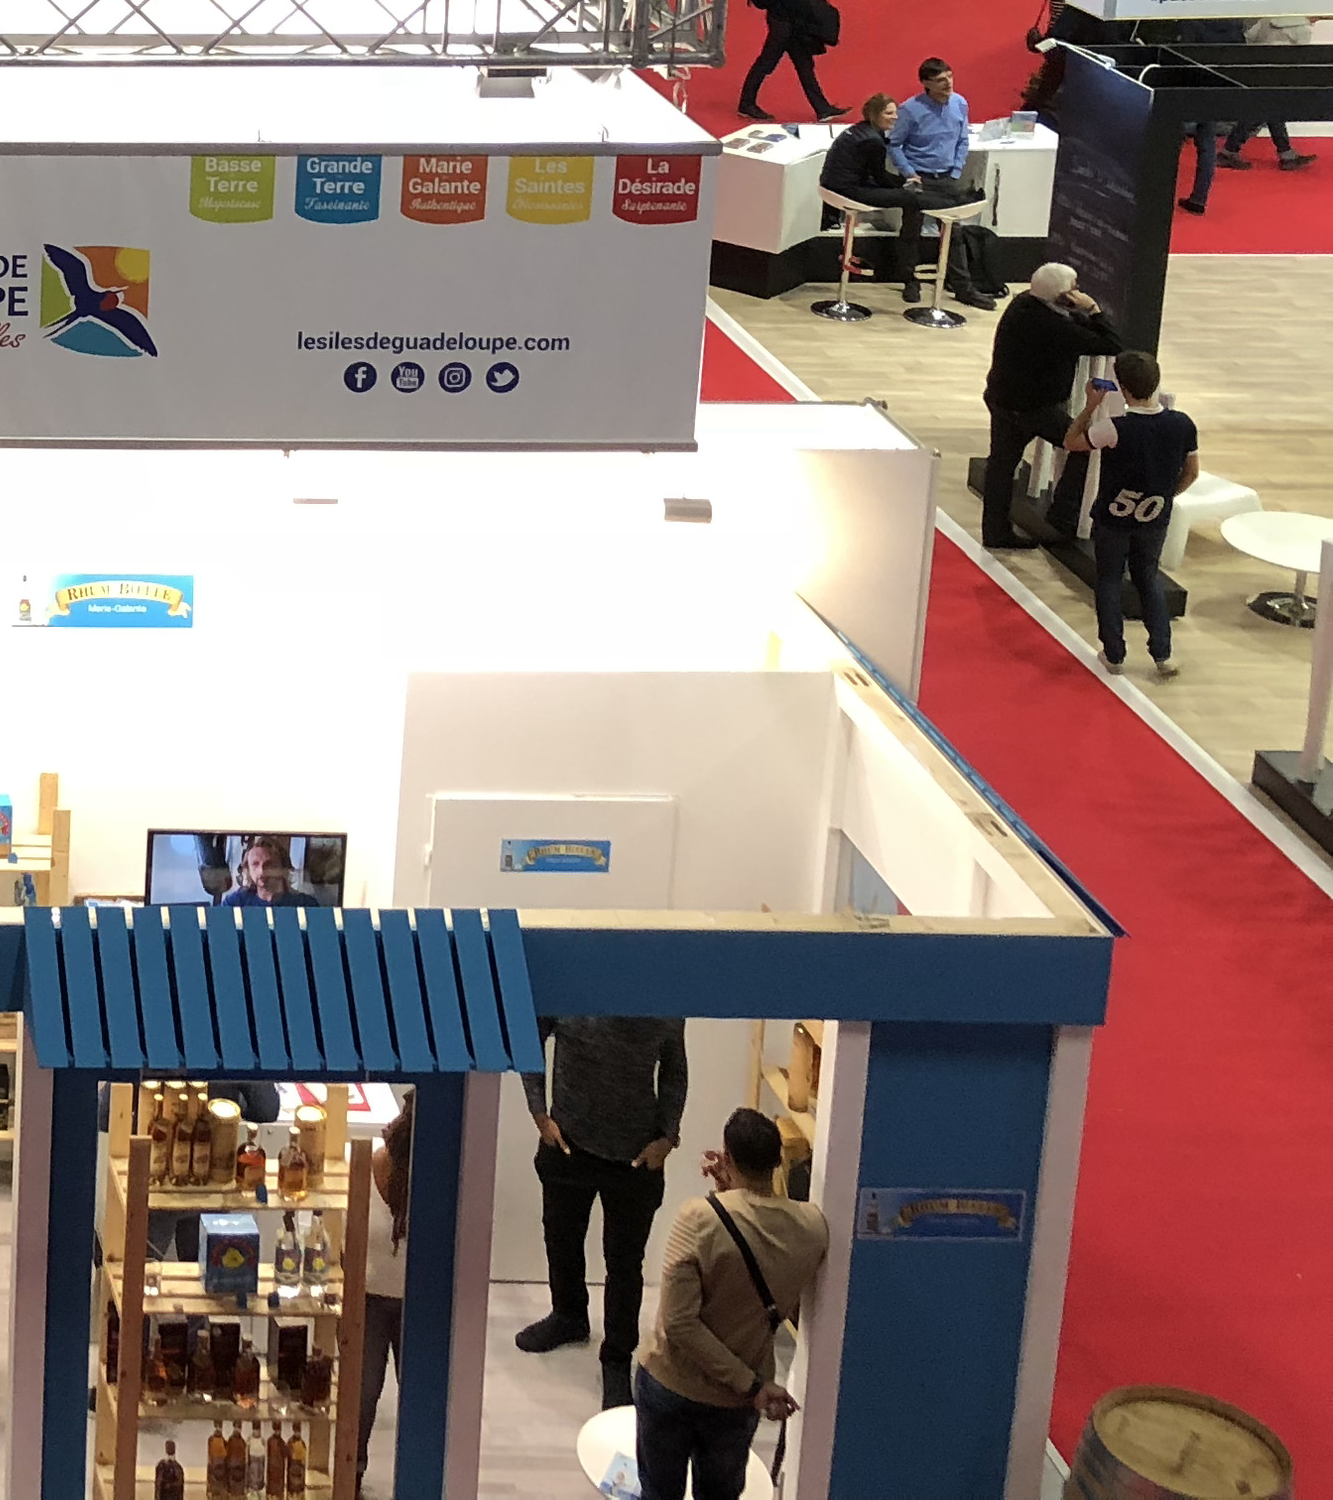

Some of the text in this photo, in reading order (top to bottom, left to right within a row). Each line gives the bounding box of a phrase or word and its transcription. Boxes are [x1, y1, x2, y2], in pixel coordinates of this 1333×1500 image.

[205, 157, 261, 173] Basse
[306, 157, 373, 174] Grande
[419, 157, 473, 174] Marie
[535, 157, 568, 174] Les
[647, 157, 669, 174] La
[206, 176, 259, 192] Terre
[312, 178, 365, 194] Terre
[408, 177, 481, 195] Galante
[515, 177, 585, 194] Saintes
[618, 177, 696, 195] Désirade
[304, 196, 371, 212] Fascinante
[297, 330, 571, 355] lesilesdeguadeloupe.com
[1109, 489, 1165, 523] 50
